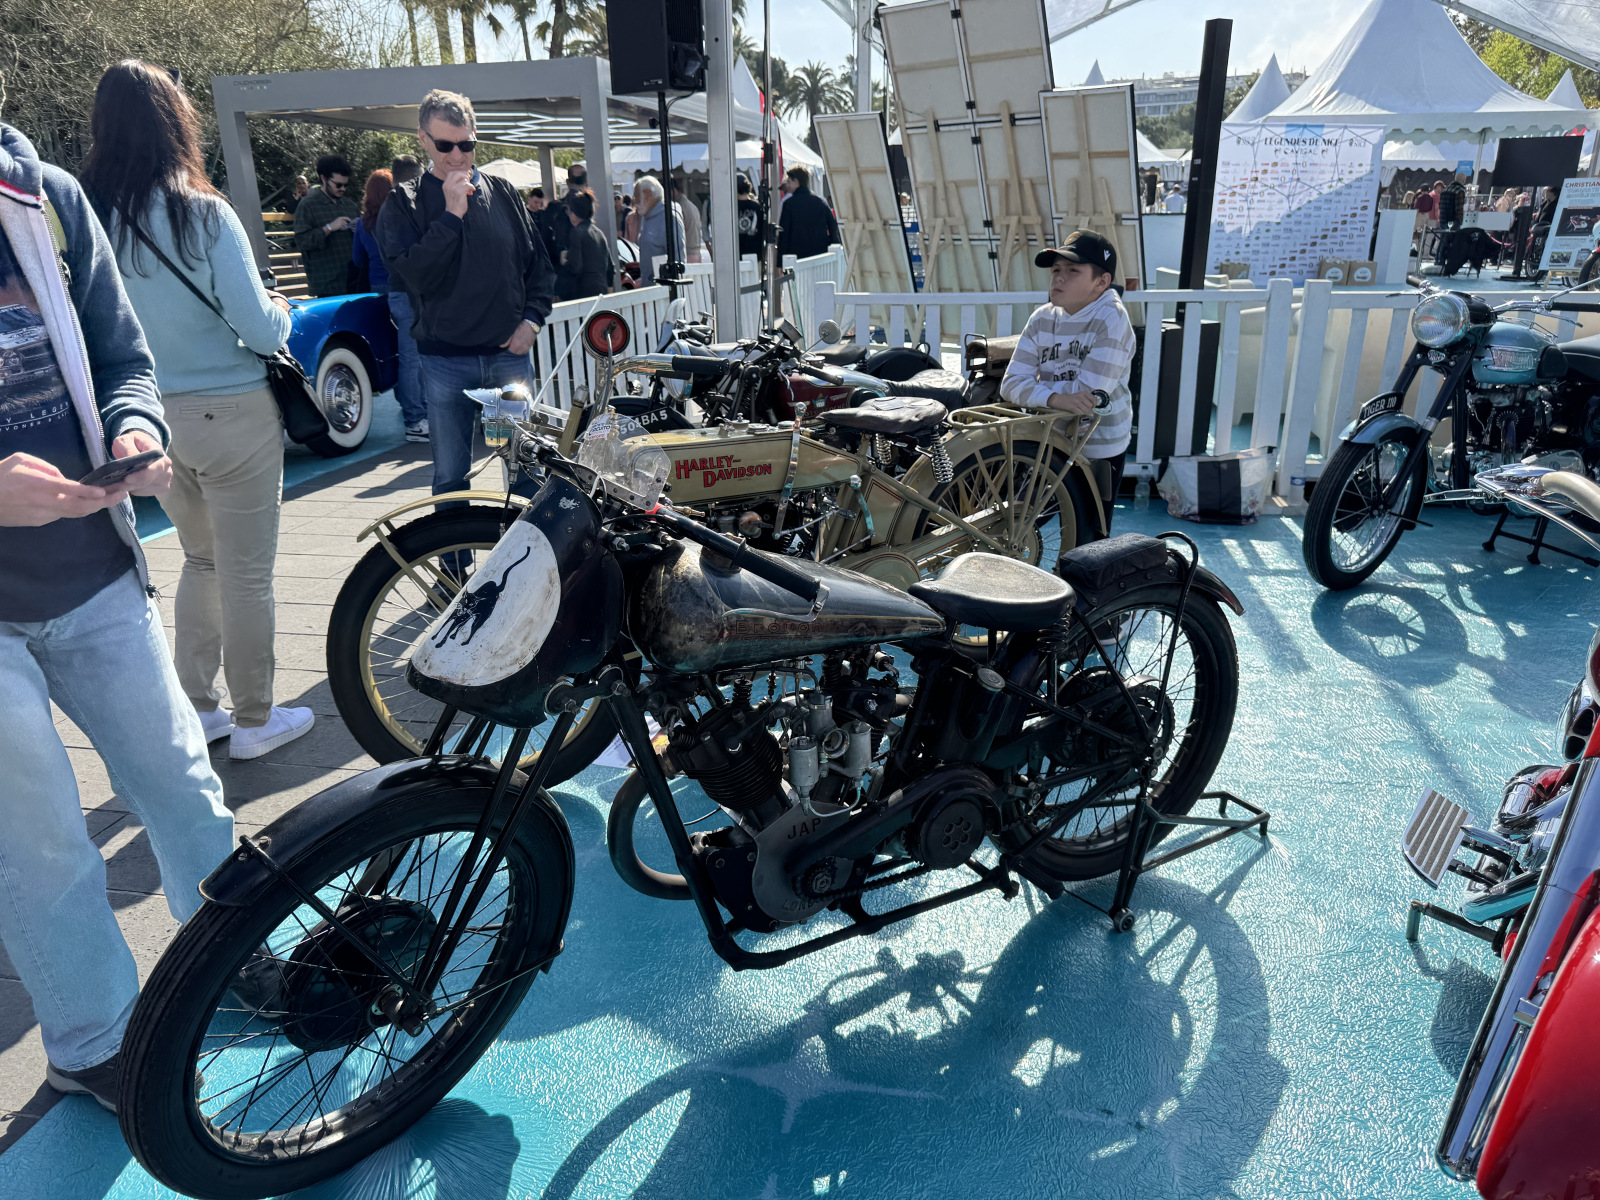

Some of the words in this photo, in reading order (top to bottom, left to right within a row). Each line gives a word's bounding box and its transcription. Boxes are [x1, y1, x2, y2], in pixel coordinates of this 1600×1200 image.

[1565, 181, 1600, 189] CHRISTIAN
[1364, 398, 1386, 419] TIGER
[703, 463, 772, 488] DAVIDSON
[735, 619, 824, 637] Brough
[787, 817, 822, 840] JAP
